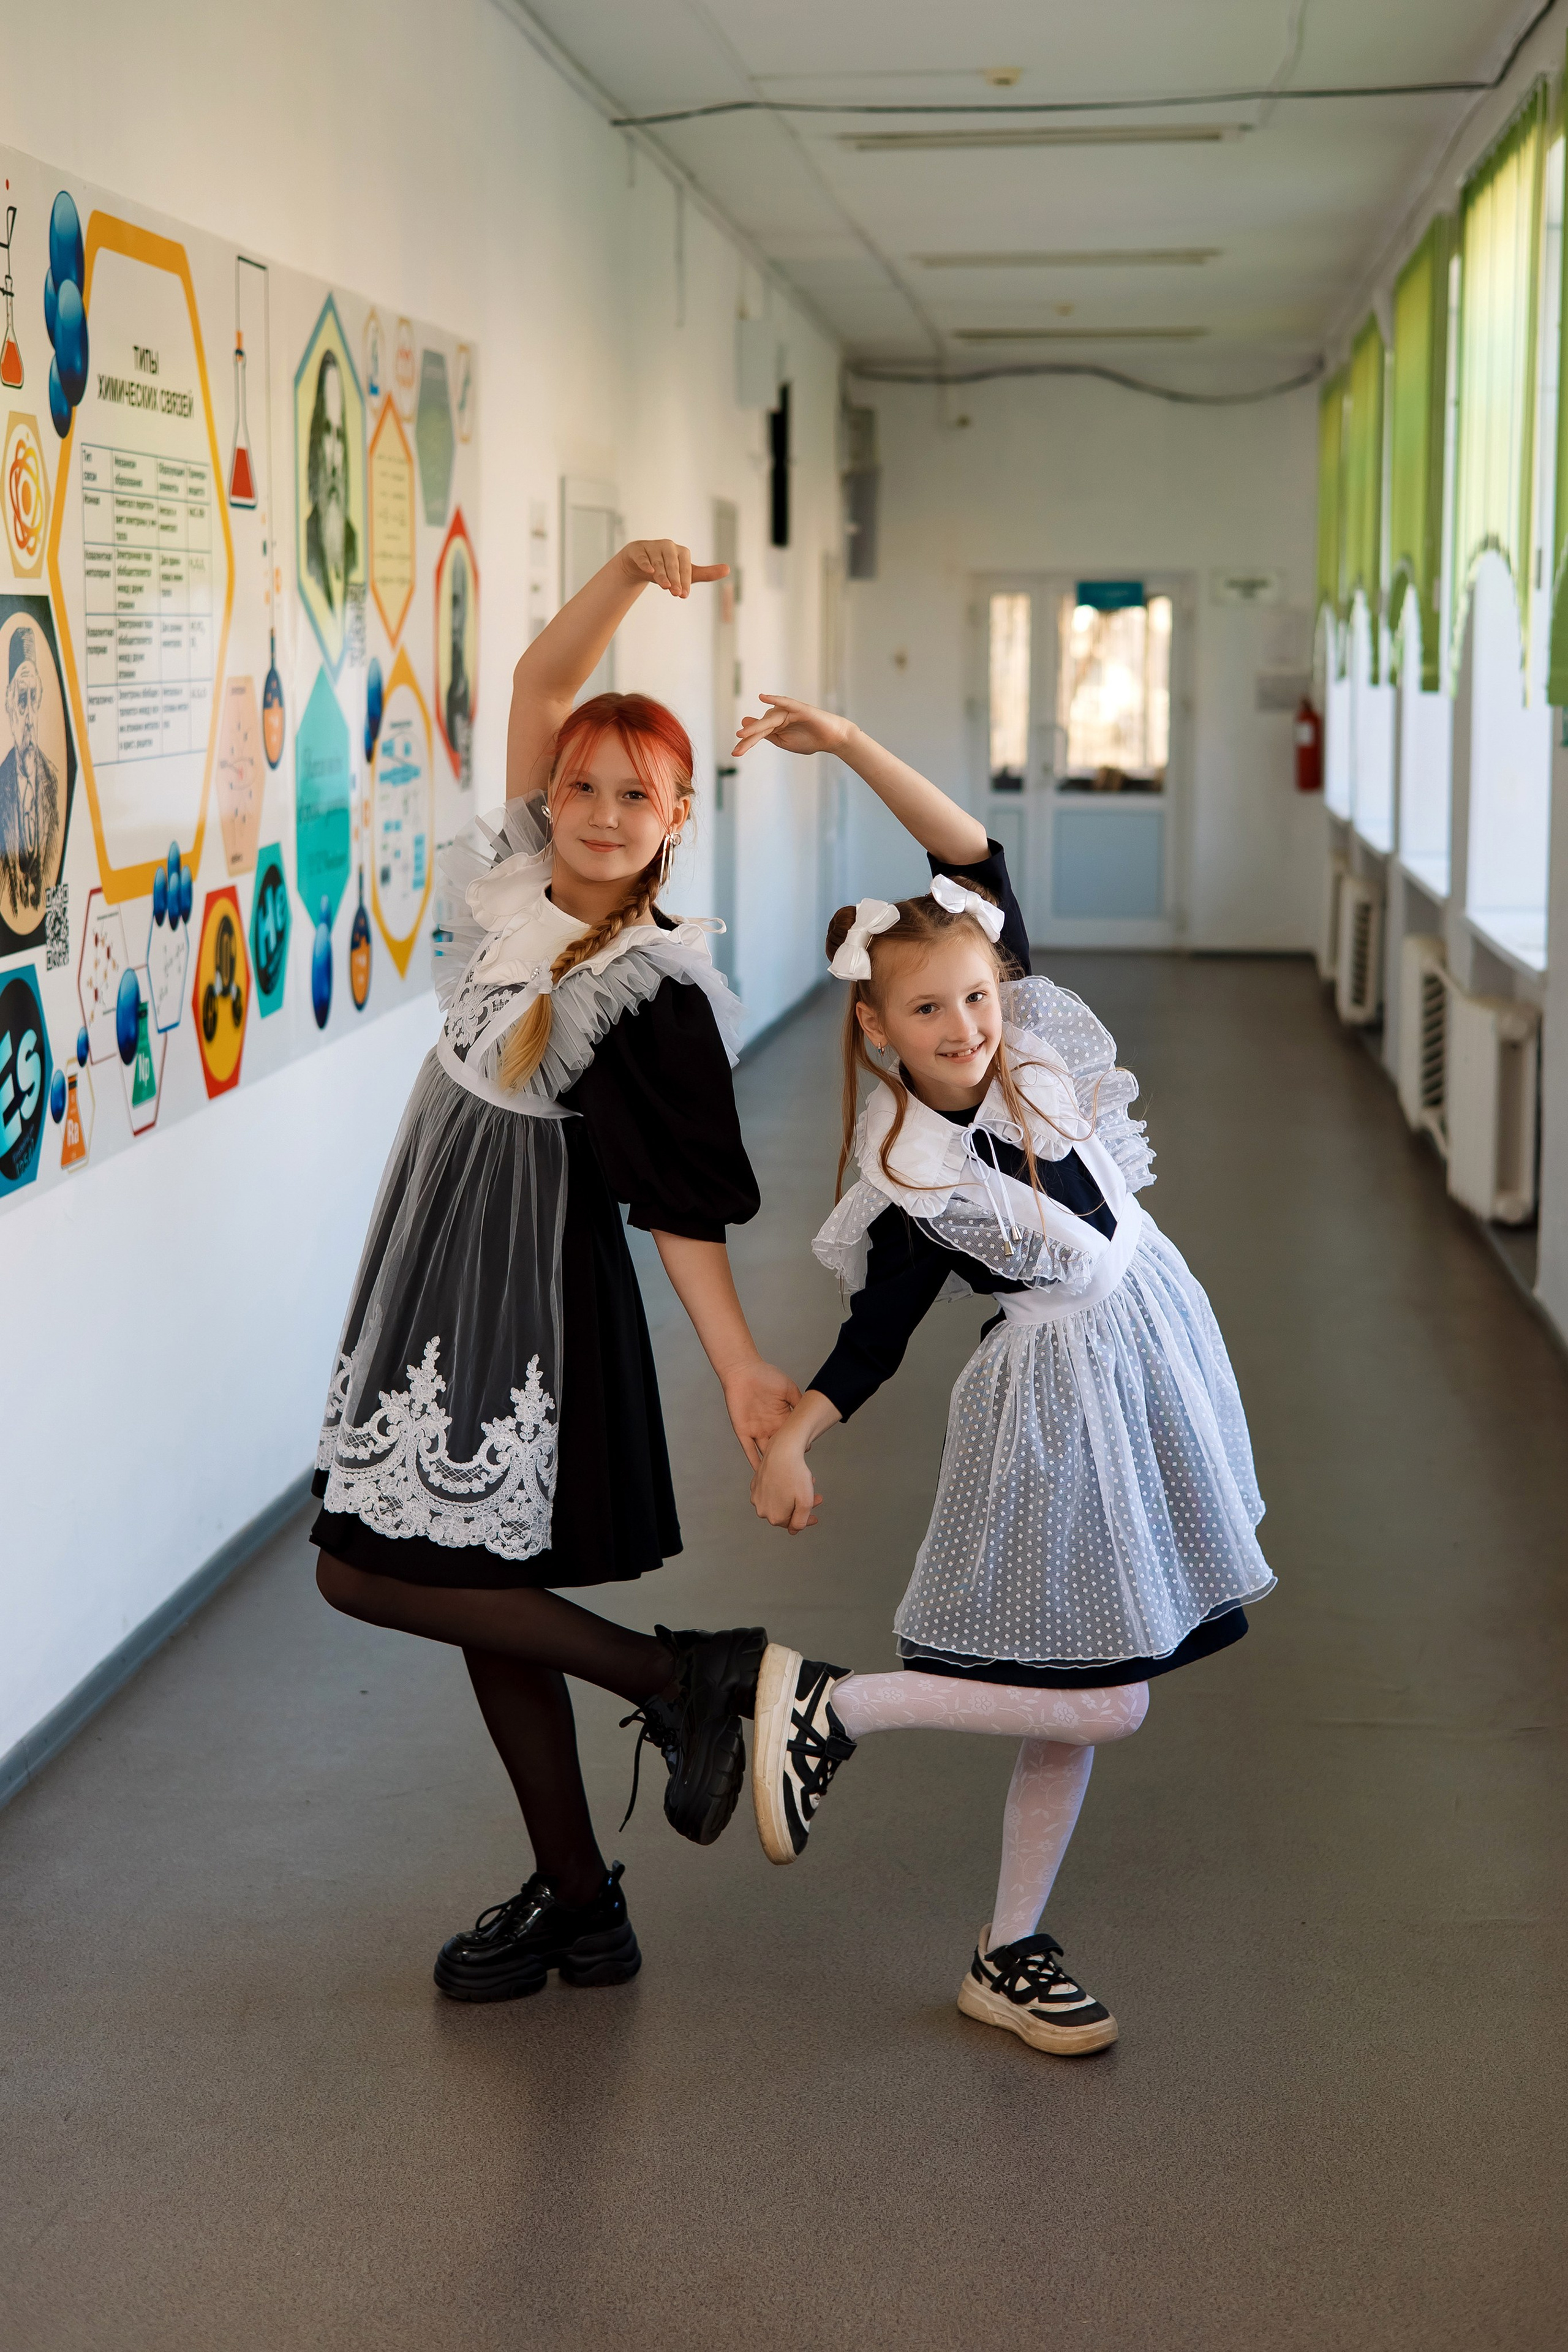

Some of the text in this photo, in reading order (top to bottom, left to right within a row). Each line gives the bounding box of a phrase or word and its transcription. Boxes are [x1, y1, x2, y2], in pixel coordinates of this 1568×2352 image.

[133, 345, 159, 375] ТИПЫ
[97, 374, 194, 419] ХИМИЧЕСКИХ СВЯЗЕЙ
[258, 884, 287, 968] He
[138, 1052, 150, 1087] Np
[67, 1118, 80, 1147] Ra
